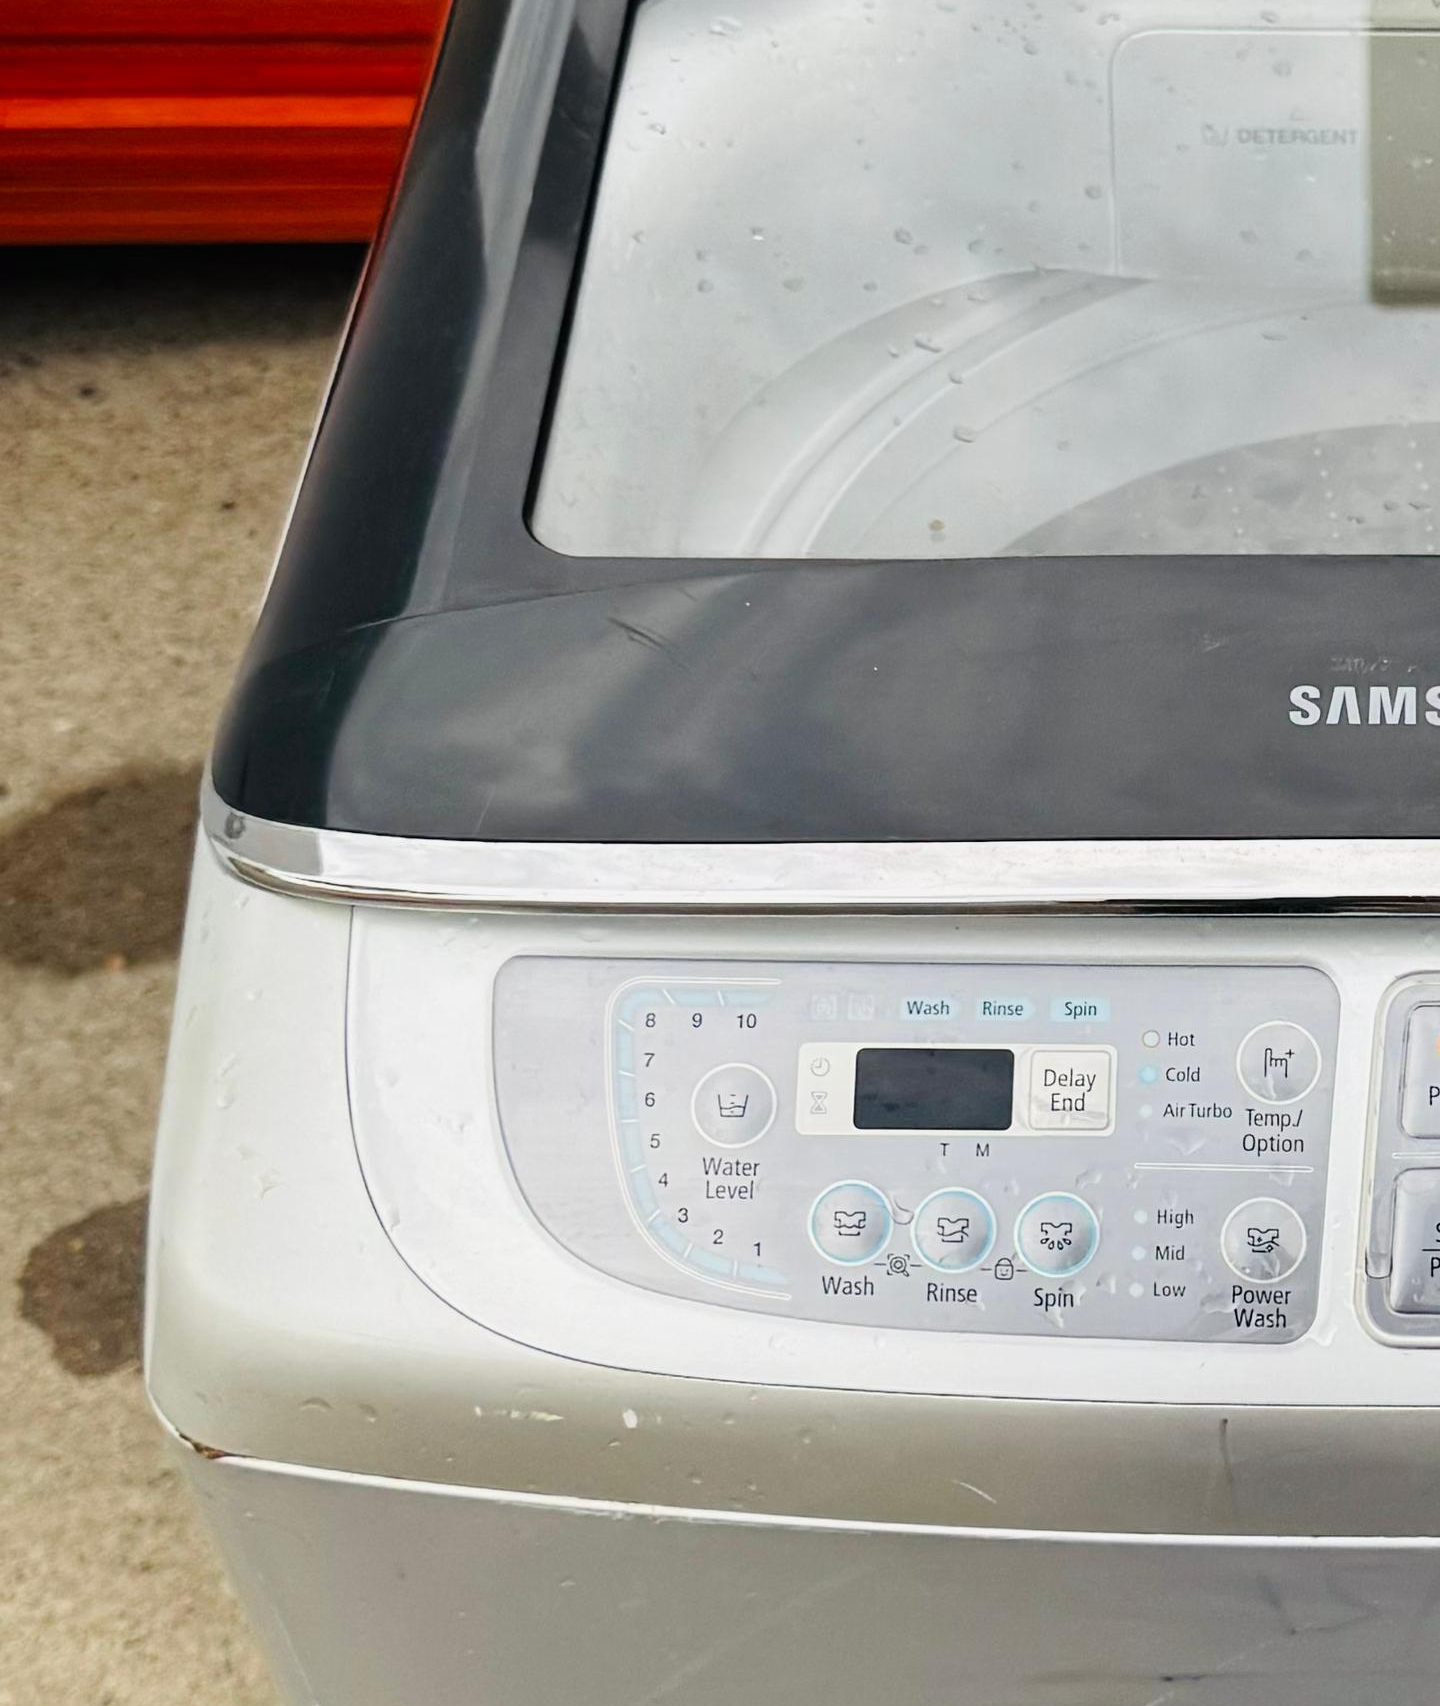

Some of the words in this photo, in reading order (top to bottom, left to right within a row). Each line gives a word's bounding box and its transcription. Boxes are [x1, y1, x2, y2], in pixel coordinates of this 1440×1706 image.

[1236, 128, 1358, 146] DETERGENT
[907, 1000, 950, 1015] Wash
[982, 1001, 1024, 1016] Rinse
[1064, 1001, 1097, 1020] Spin
[645, 1012, 656, 1028] 8
[691, 1012, 703, 1029] 9
[737, 1013, 757, 1029] 10
[1168, 1032, 1195, 1047] Hot
[644, 1052, 656, 1068] 7
[1044, 1068, 1097, 1093] Delay
[1165, 1066, 1201, 1082] Cold
[644, 1091, 656, 1108] 6
[1051, 1092, 1086, 1112] End
[1163, 1103, 1185, 1118] Air
[1189, 1102, 1233, 1118] Turbo
[1245, 1108, 1303, 1132] Temp./
[650, 1133, 660, 1149] 5
[940, 1142, 949, 1157] T
[1242, 1133, 1304, 1157] Option
[976, 1143, 990, 1157] M
[702, 1157, 760, 1177] Water
[658, 1172, 668, 1187] 4
[706, 1180, 754, 1200] Level
[678, 1207, 689, 1224] 3
[1157, 1209, 1194, 1229] High
[712, 1229, 724, 1245] 2
[754, 1242, 761, 1257] 1
[1155, 1245, 1185, 1261] Mid
[822, 1275, 874, 1296] Wash
[927, 1282, 978, 1303] Rinse
[1153, 1282, 1186, 1297] Low
[1033, 1287, 1074, 1312] Spin
[1232, 1285, 1292, 1305] Power
[1233, 1307, 1287, 1329] Wash
